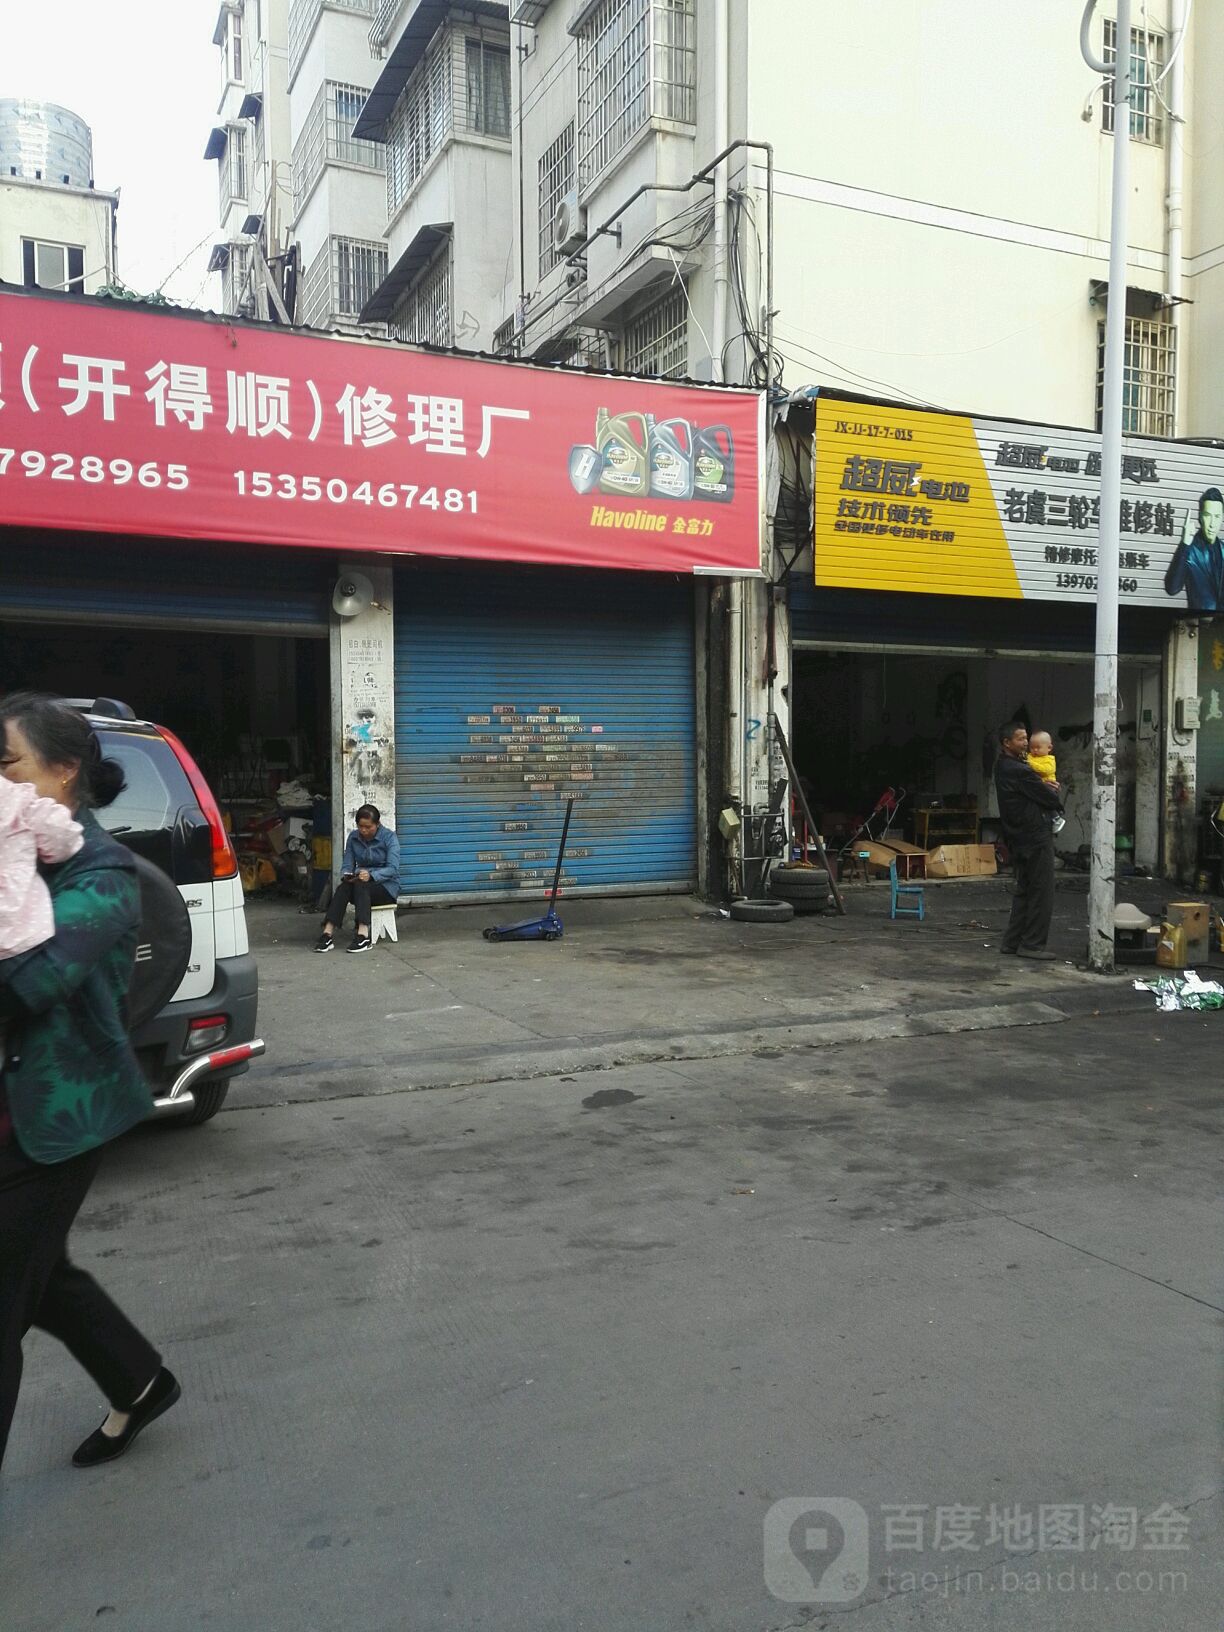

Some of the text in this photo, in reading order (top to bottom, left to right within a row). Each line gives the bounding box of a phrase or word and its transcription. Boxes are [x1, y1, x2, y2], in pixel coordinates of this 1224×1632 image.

[234, 470, 478, 514] 15350467481
[840, 455, 970, 503] 超威电池
[590, 505, 713, 536] Havoline 金富力
[837, 498, 933, 526] 技术领先
